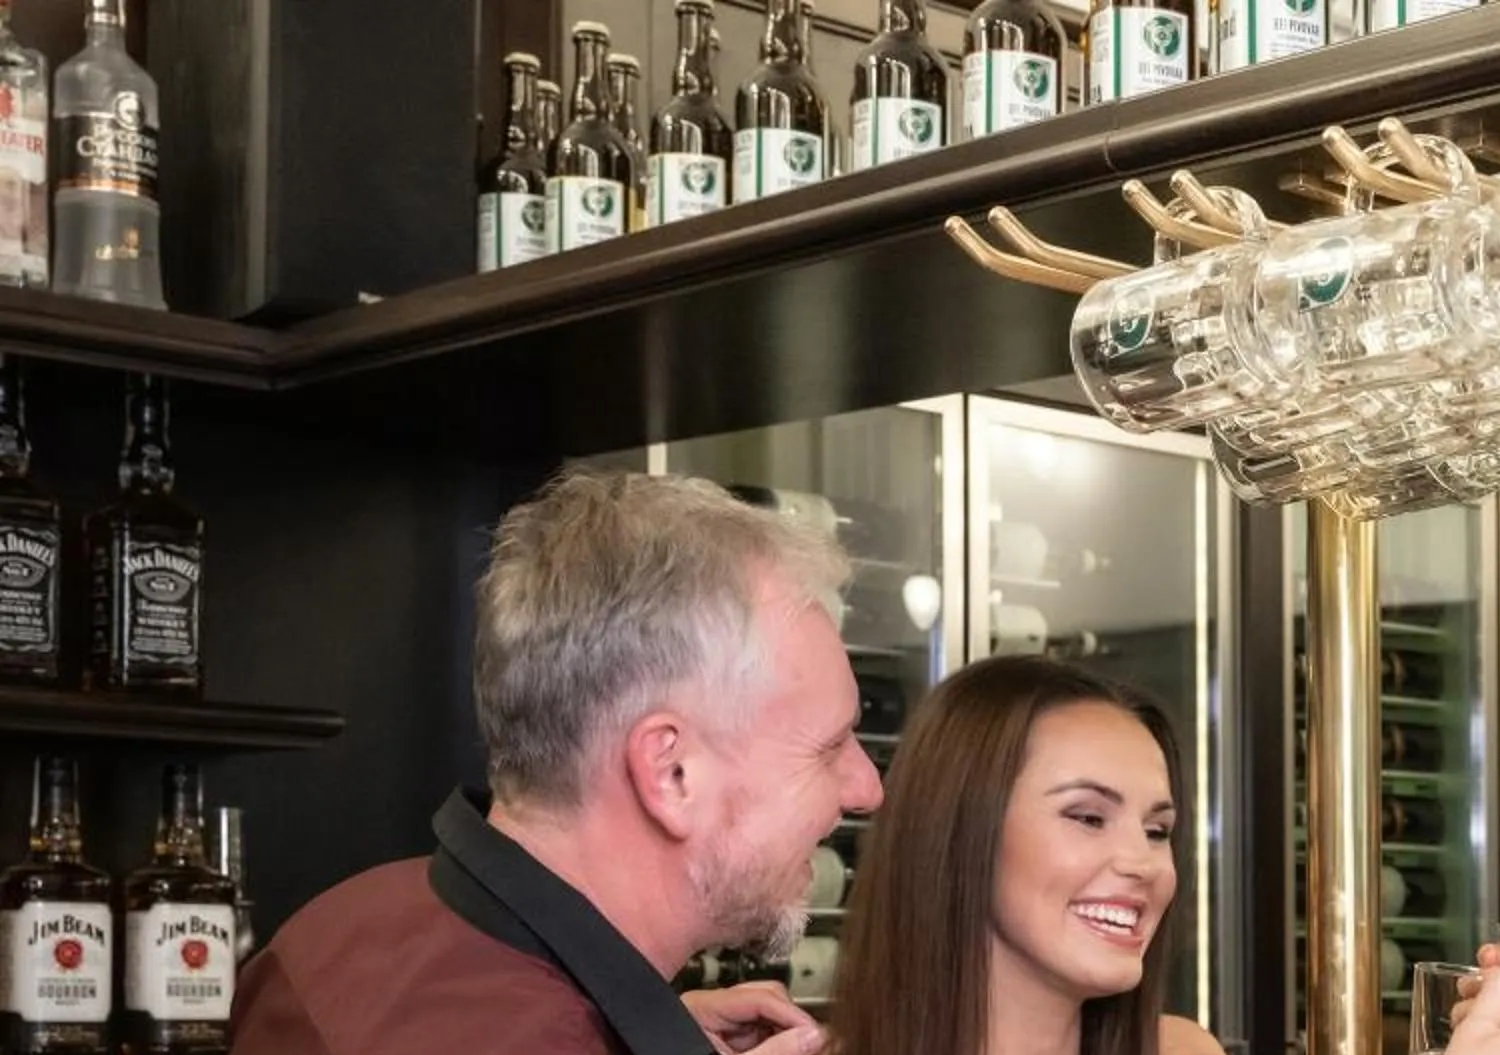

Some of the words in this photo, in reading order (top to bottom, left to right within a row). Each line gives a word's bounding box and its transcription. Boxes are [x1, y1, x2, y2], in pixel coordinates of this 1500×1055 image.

[28, 921, 59, 946] JIM
[63, 914, 105, 948] BEAM
[156, 922, 186, 946] JIM
[190, 915, 230, 948] BEAM
